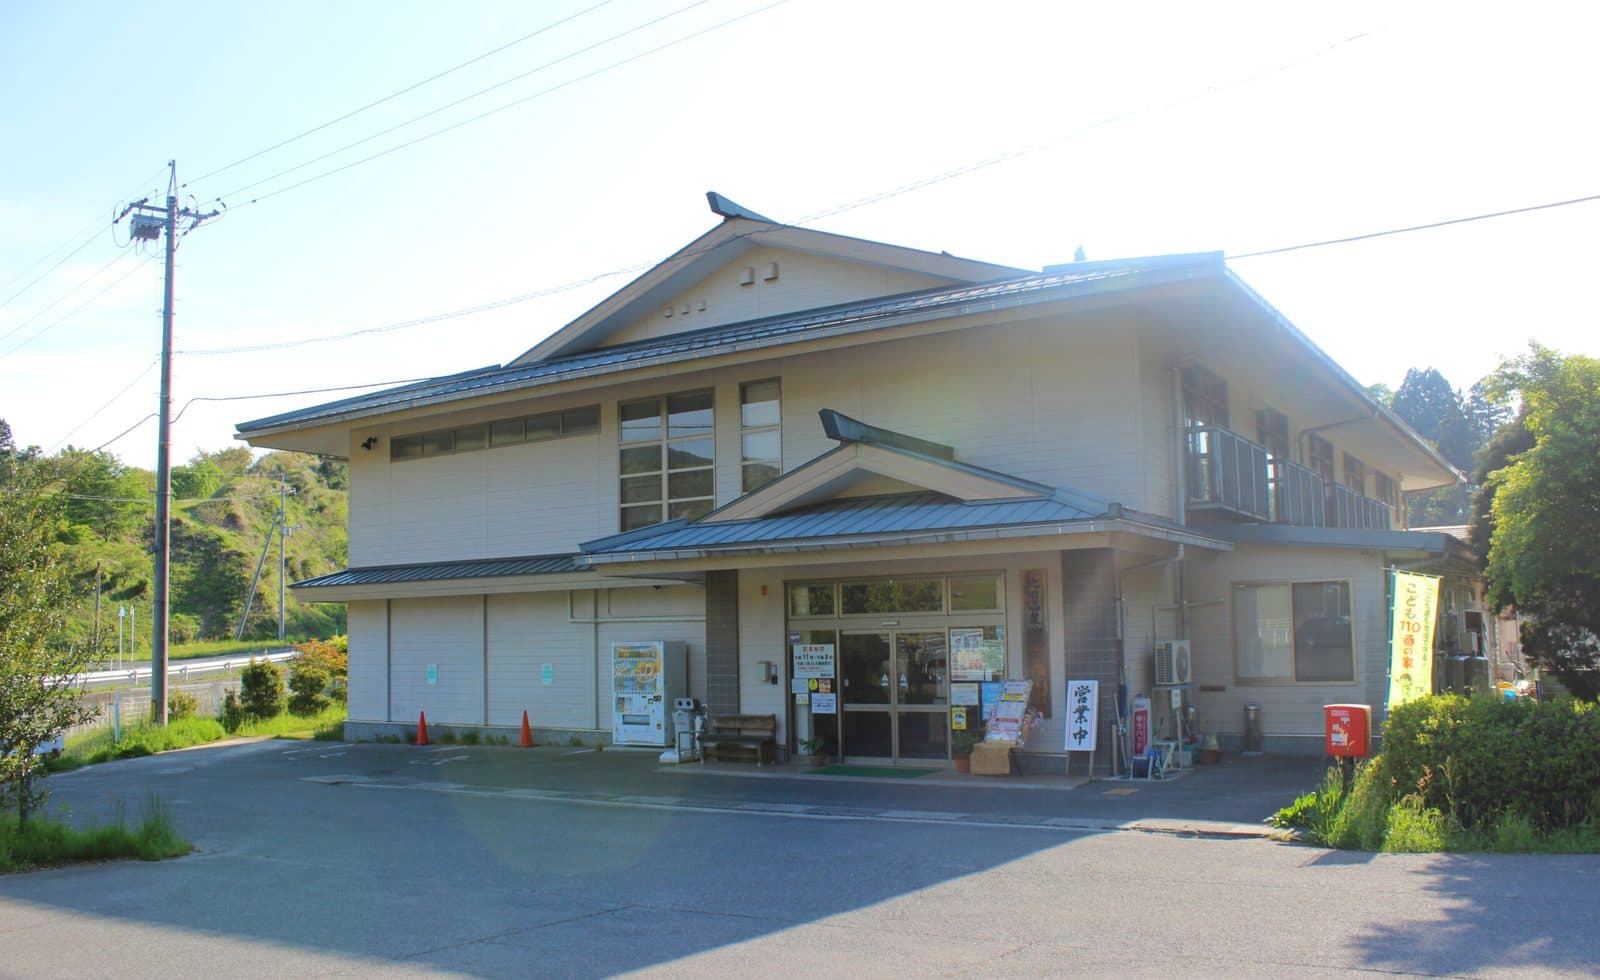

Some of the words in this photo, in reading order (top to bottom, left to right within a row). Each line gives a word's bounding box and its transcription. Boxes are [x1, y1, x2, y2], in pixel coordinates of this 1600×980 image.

[1400, 583, 1420, 669] こども110番の家
[1073, 686, 1091, 746] 営業中
